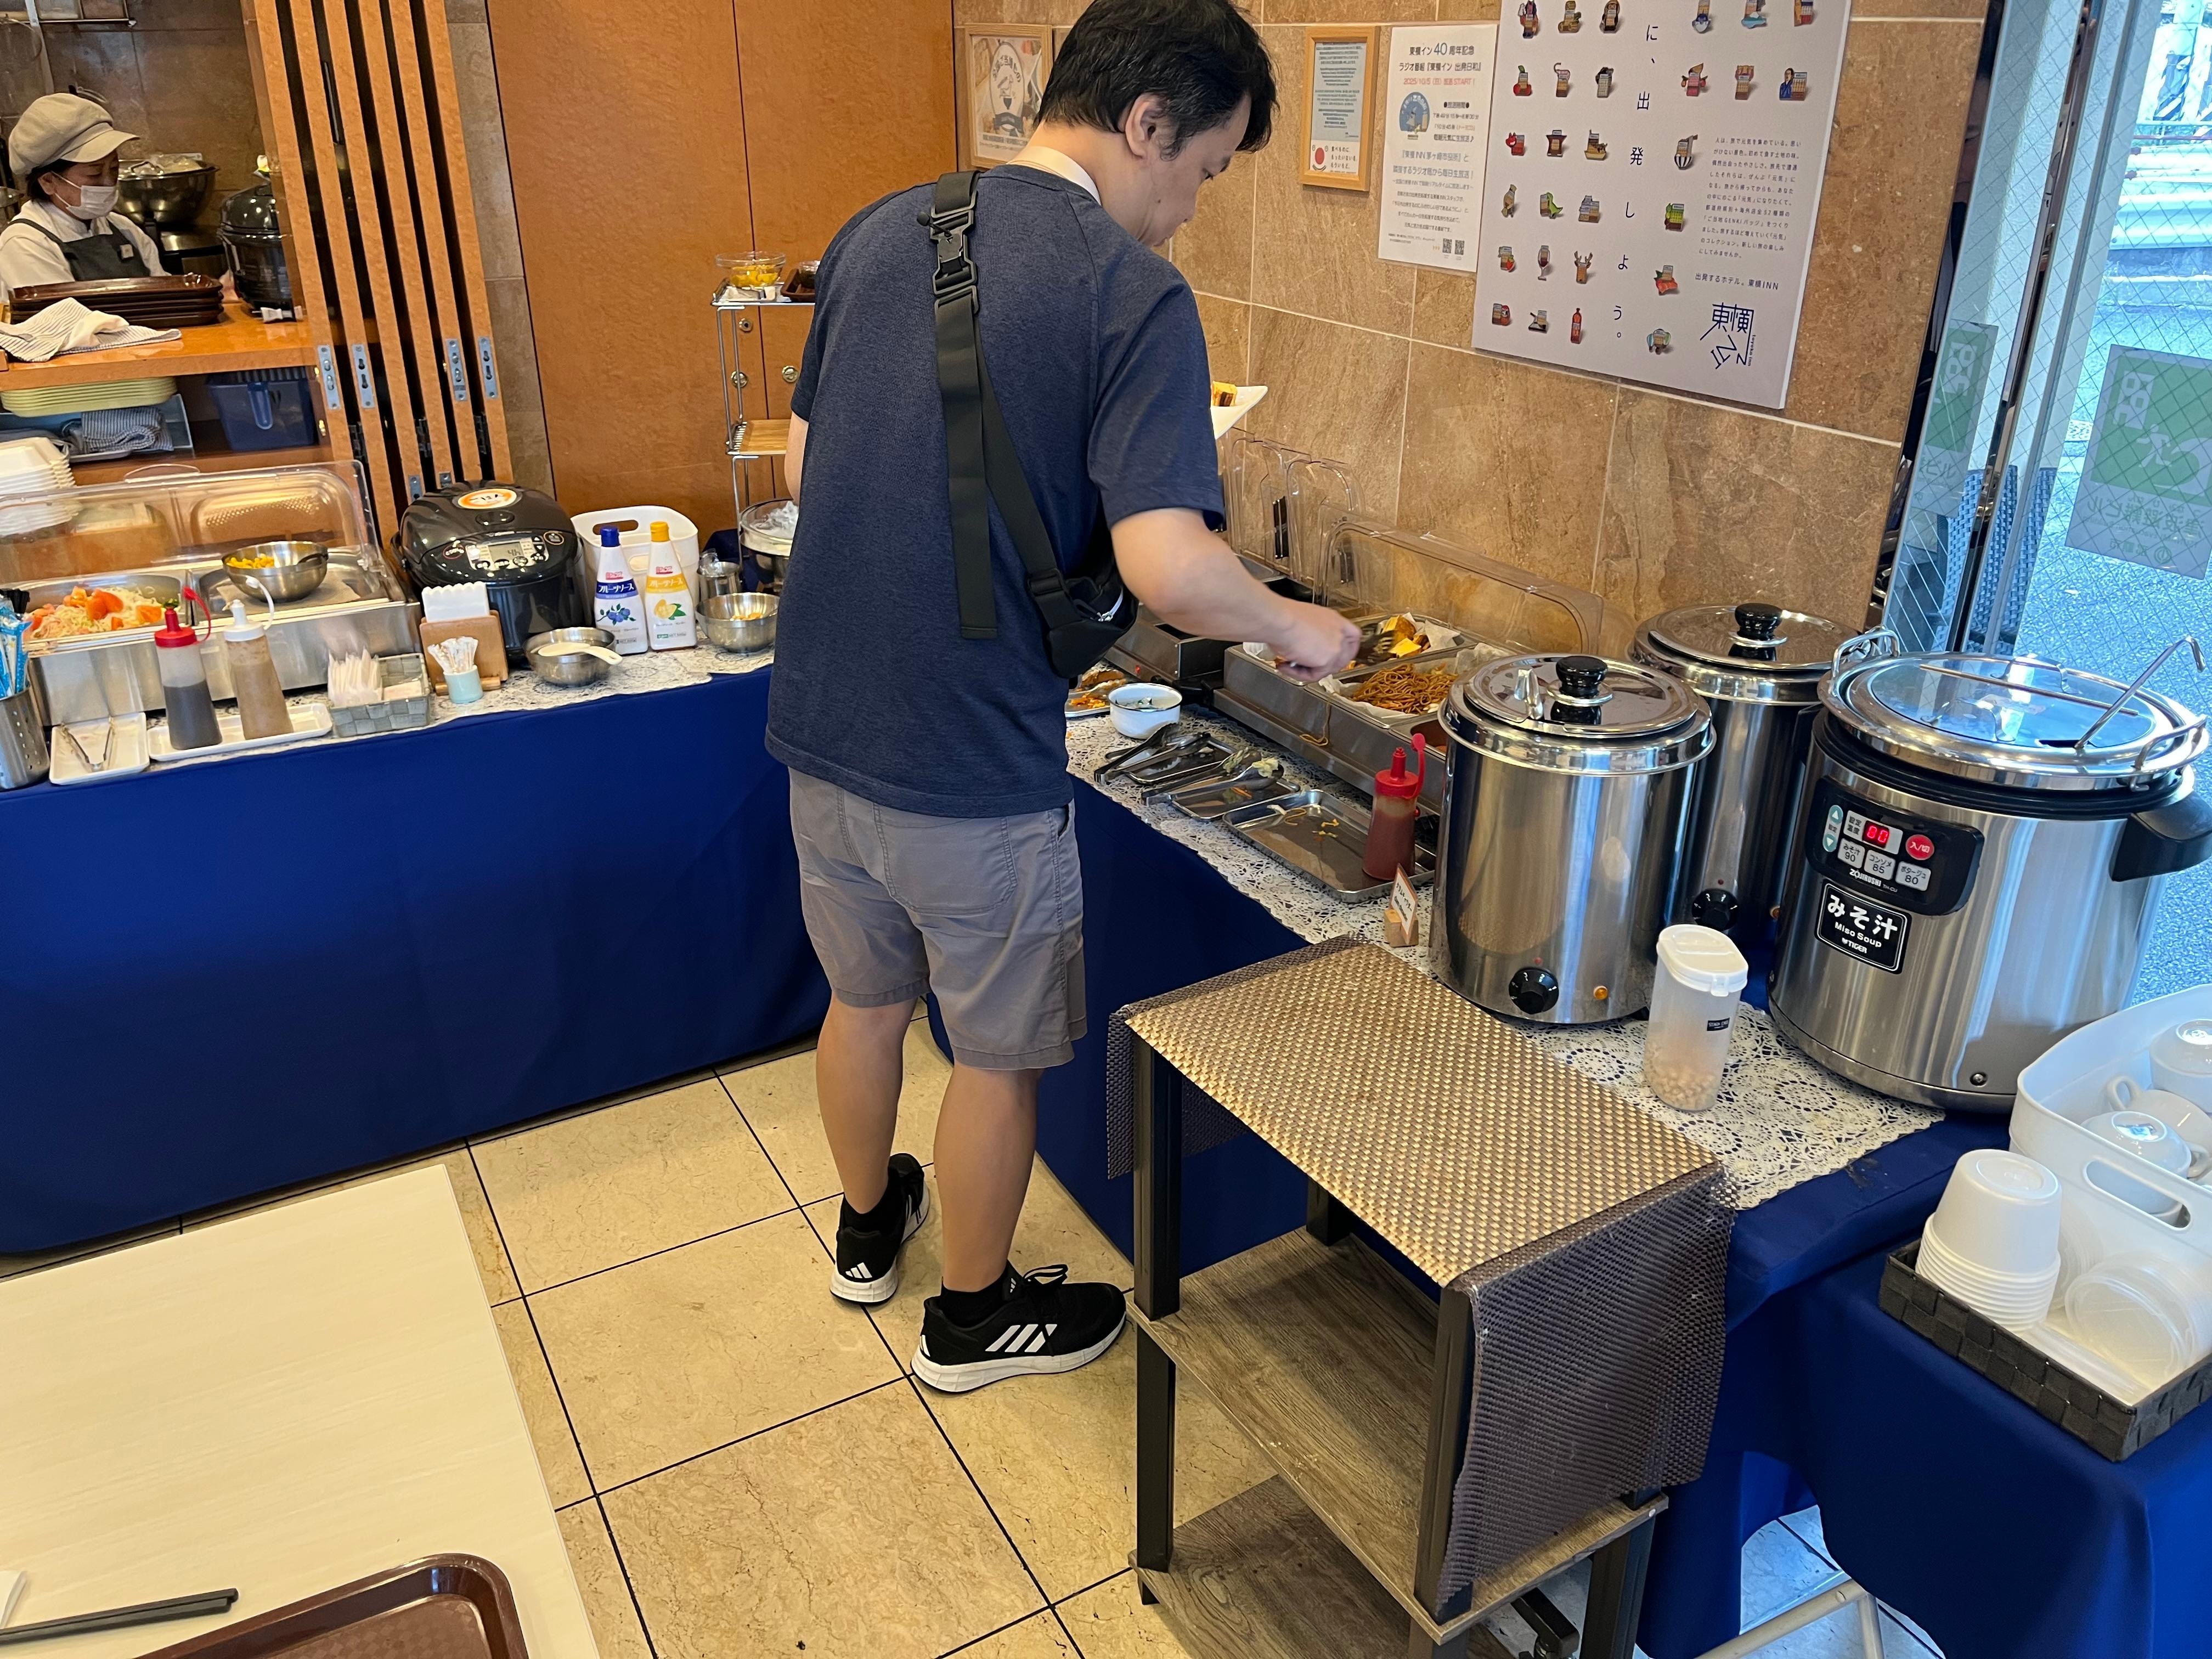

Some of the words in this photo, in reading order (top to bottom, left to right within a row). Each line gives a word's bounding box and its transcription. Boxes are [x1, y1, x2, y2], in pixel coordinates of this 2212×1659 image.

[1695, 273, 1779, 290] 出発するホテル。東横INN
[1844, 852, 1856, 862] 90
[1869, 854, 1892, 867] コンソメ
[1872, 864, 1885, 874] 85
[1905, 875, 1918, 884] 80
[1827, 894, 1898, 940] みそ汁
[1835, 922, 1855, 936] Miso
[1857, 933, 1882, 947] Soup
[1848, 940, 1867, 953] TIGER
